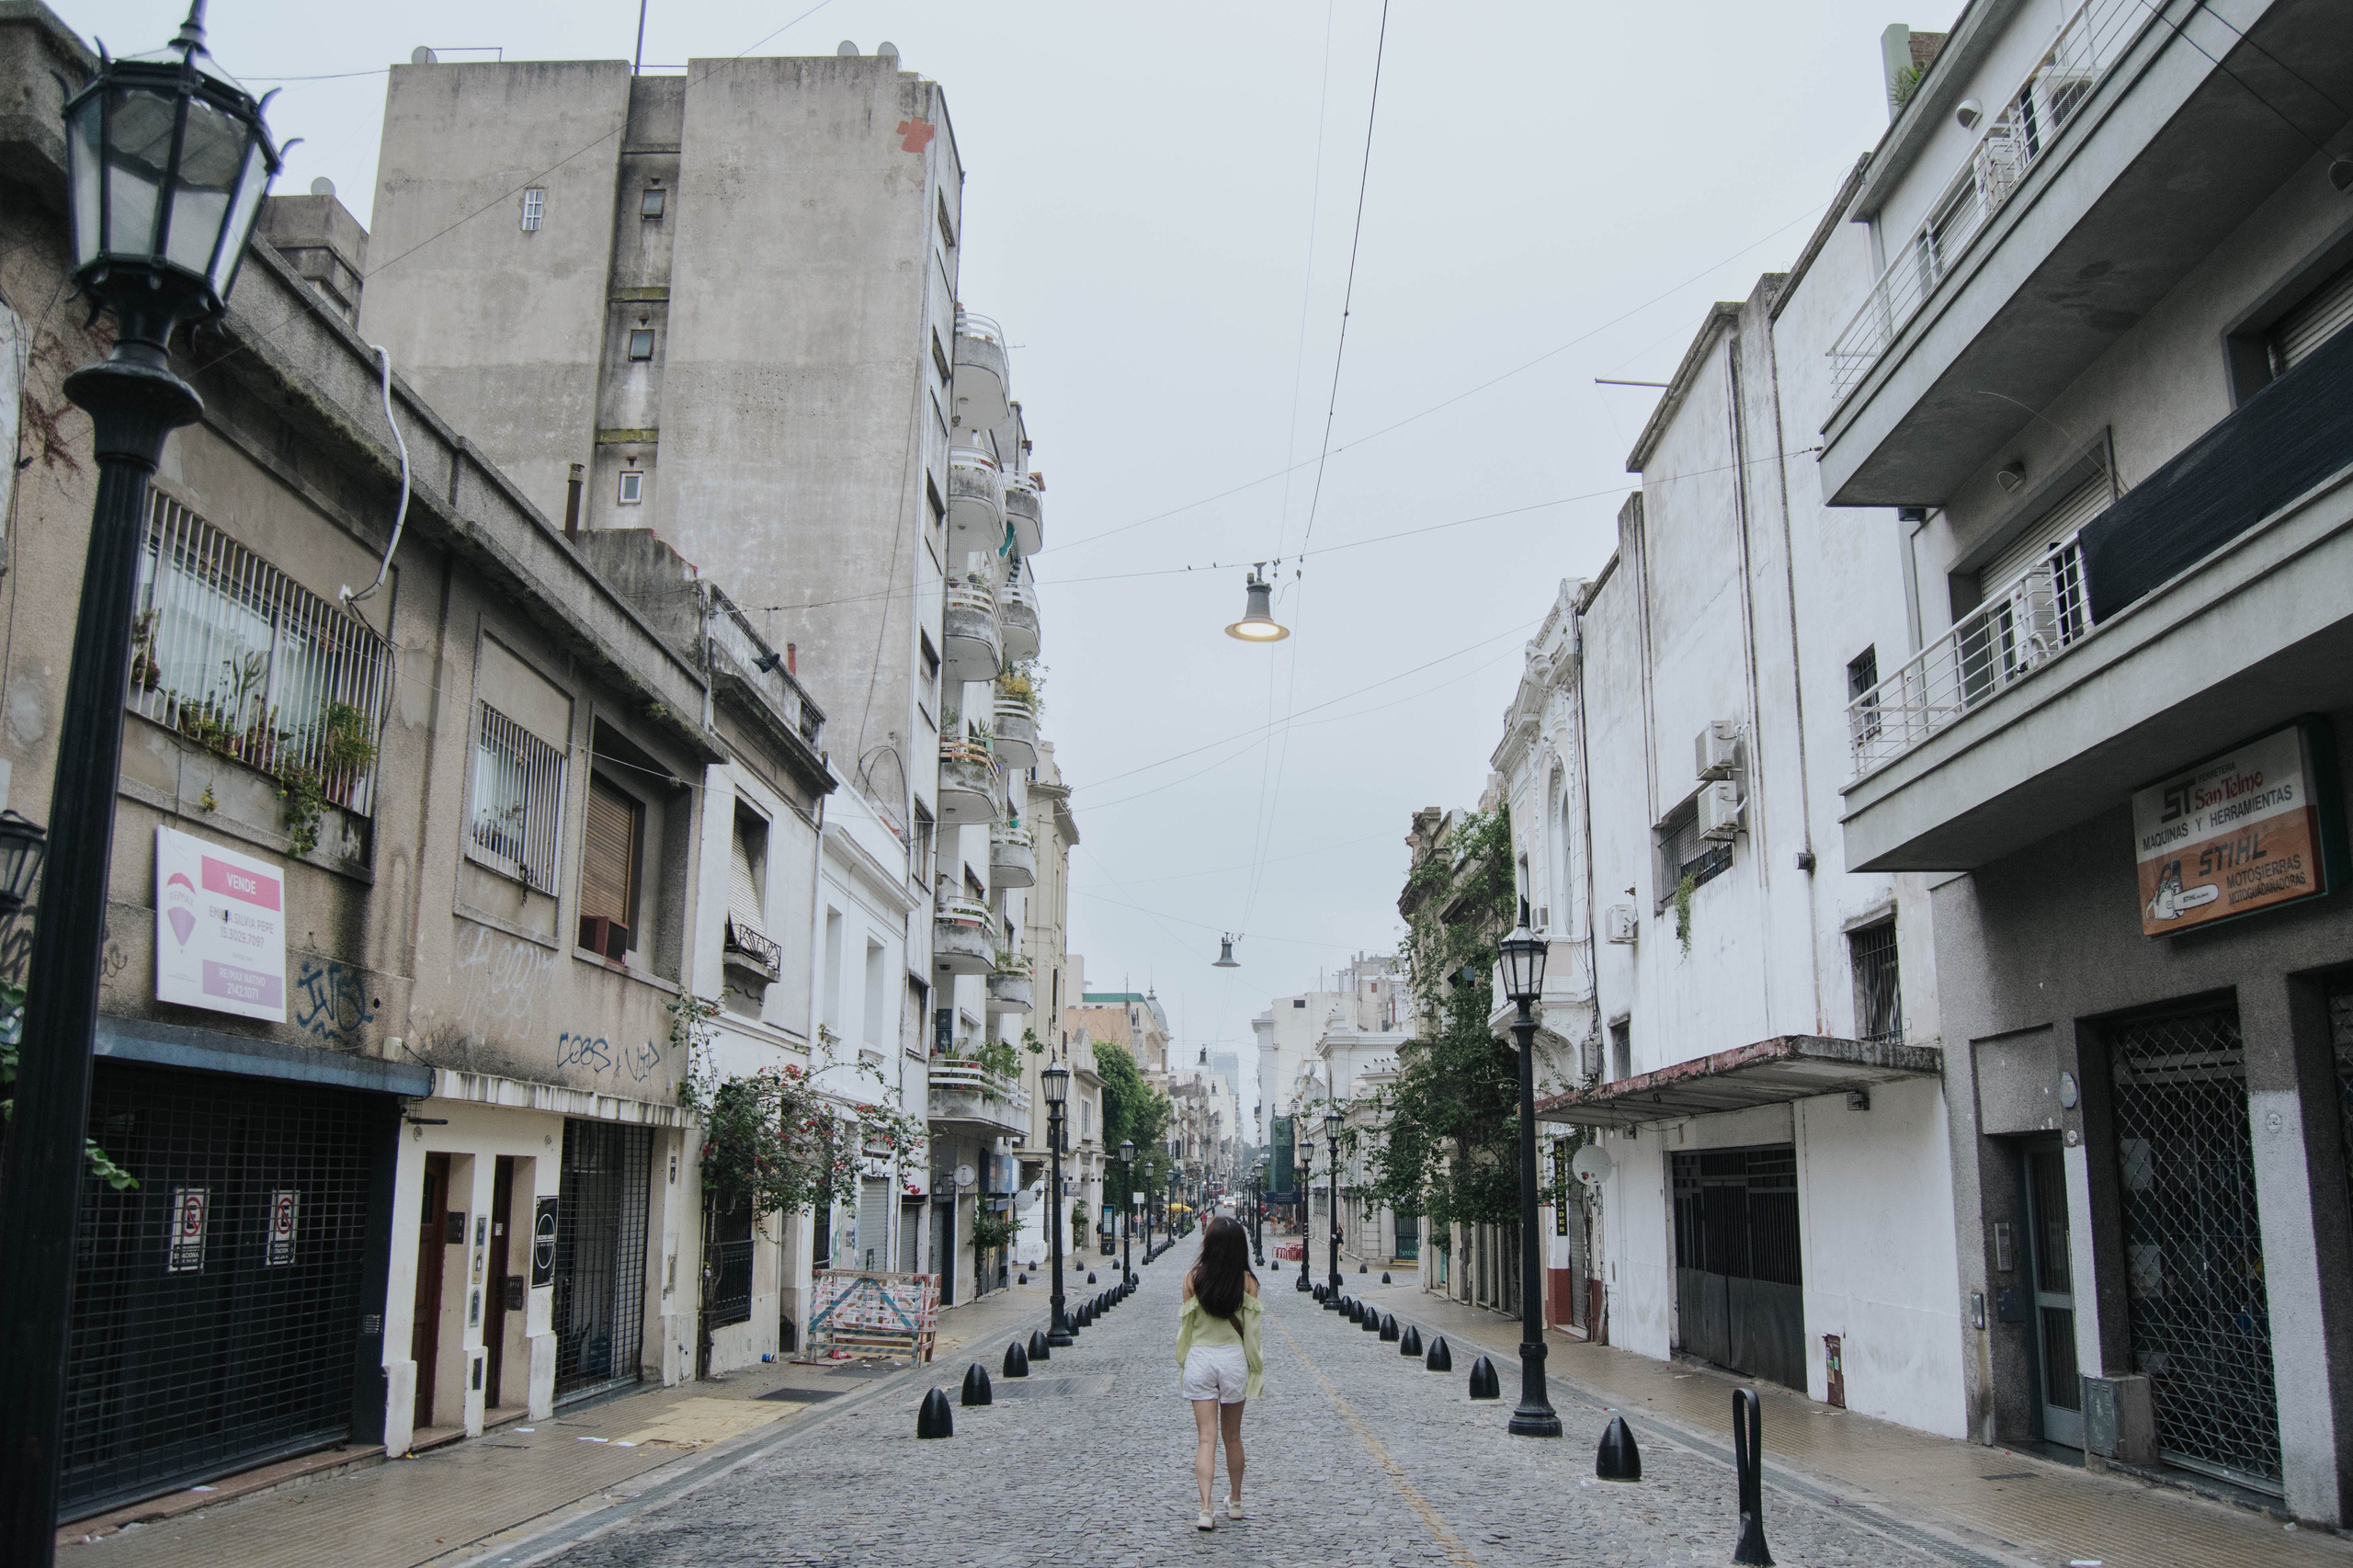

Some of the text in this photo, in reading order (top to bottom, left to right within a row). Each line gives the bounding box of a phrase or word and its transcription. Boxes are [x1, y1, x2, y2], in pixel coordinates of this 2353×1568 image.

[2198, 761, 2235, 783] FERRETERIA
[2161, 778, 2196, 824] ST
[2195, 771, 2264, 811] San Telmo
[2143, 785, 2292, 852] MAQUINAS Y HERRAMIENTAS
[2199, 833, 2268, 878] STIHL
[226, 872, 256, 895] VENDE
[2226, 855, 2302, 889] MOTOSIERRAS
[169, 891, 195, 907] RE/MAX
[2228, 872, 2306, 905] MOTOGUADAÑADORAS
[209, 905, 275, 935] EMIA SILVIA PEPE
[220, 926, 265, 949] 15.3029.7097
[219, 967, 267, 987] RE/MAX NATIVO
[226, 982, 259, 1000] 2142.1071
